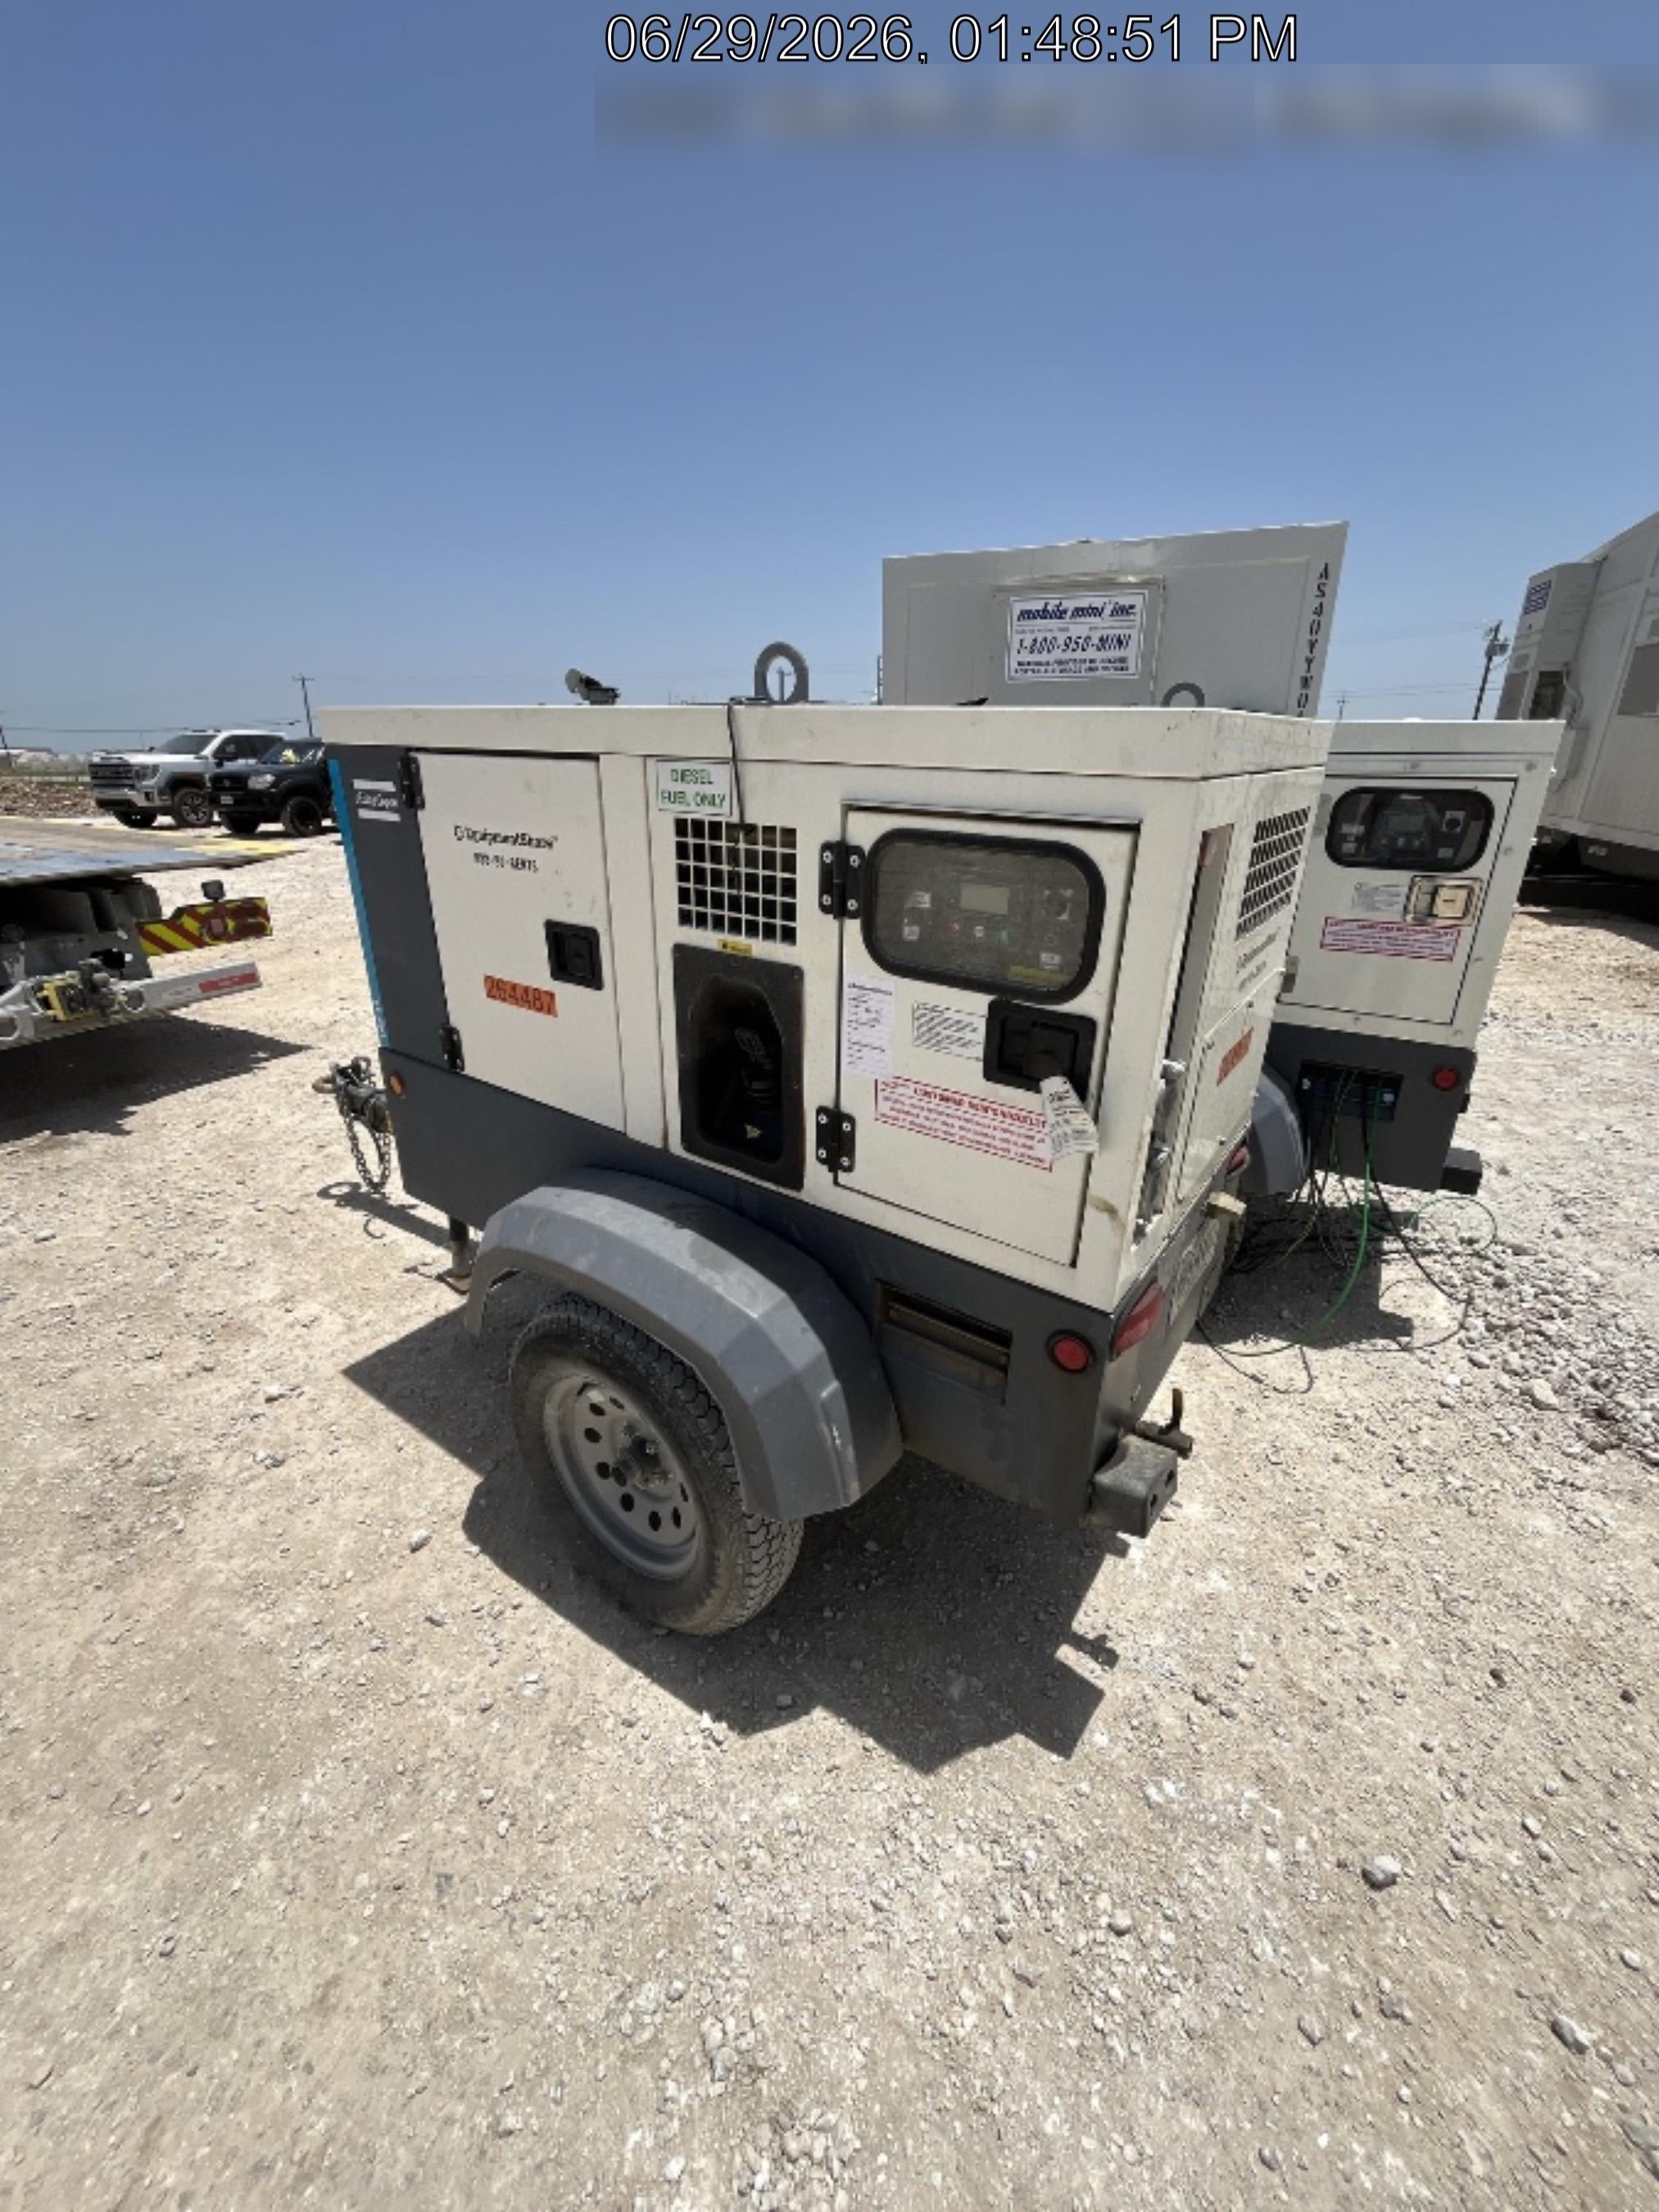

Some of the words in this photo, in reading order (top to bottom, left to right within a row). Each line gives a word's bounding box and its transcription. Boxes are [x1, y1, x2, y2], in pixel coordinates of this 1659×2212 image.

[1016, 600, 1070, 622] mobile
[1016, 632, 1132, 655] 1-800-950-MINI
[670, 768, 714, 785] DIESEL
[661, 789, 692, 807] FUEL
[694, 791, 726, 809] ONLY
